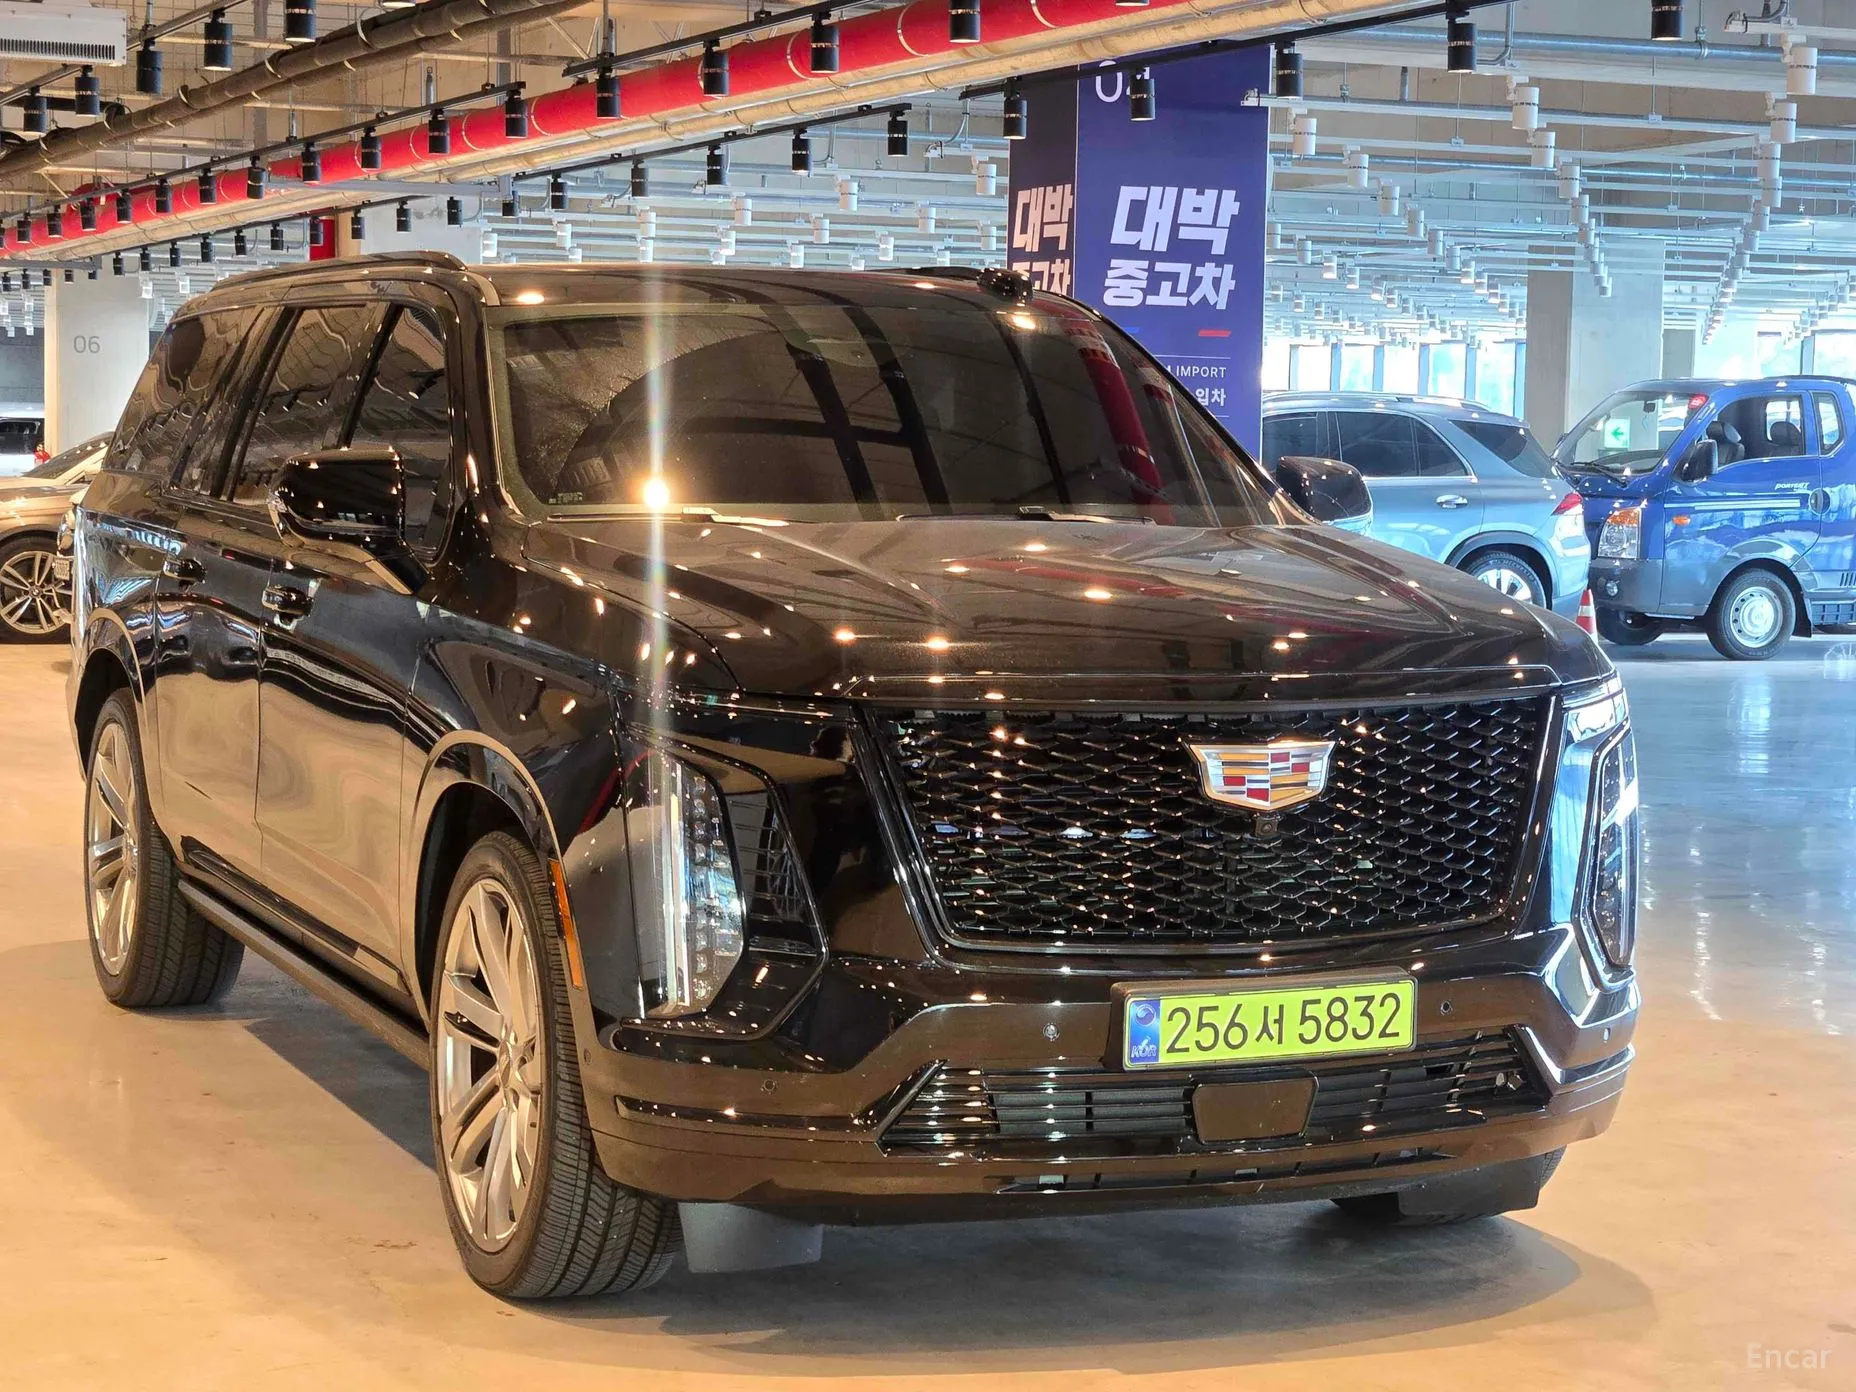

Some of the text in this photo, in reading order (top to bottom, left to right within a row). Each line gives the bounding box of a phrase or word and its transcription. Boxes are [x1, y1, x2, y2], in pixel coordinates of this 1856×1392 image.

[1013, 184, 1073, 252] 대박
[1109, 185, 1240, 255] 대박
[1103, 259, 1236, 310] 중고차
[73, 335, 101, 354] 06
[1176, 365, 1227, 378] IMPORT
[1166, 992, 1401, 1054] 256서 5832
[1131, 1044, 1157, 1058] KOR
